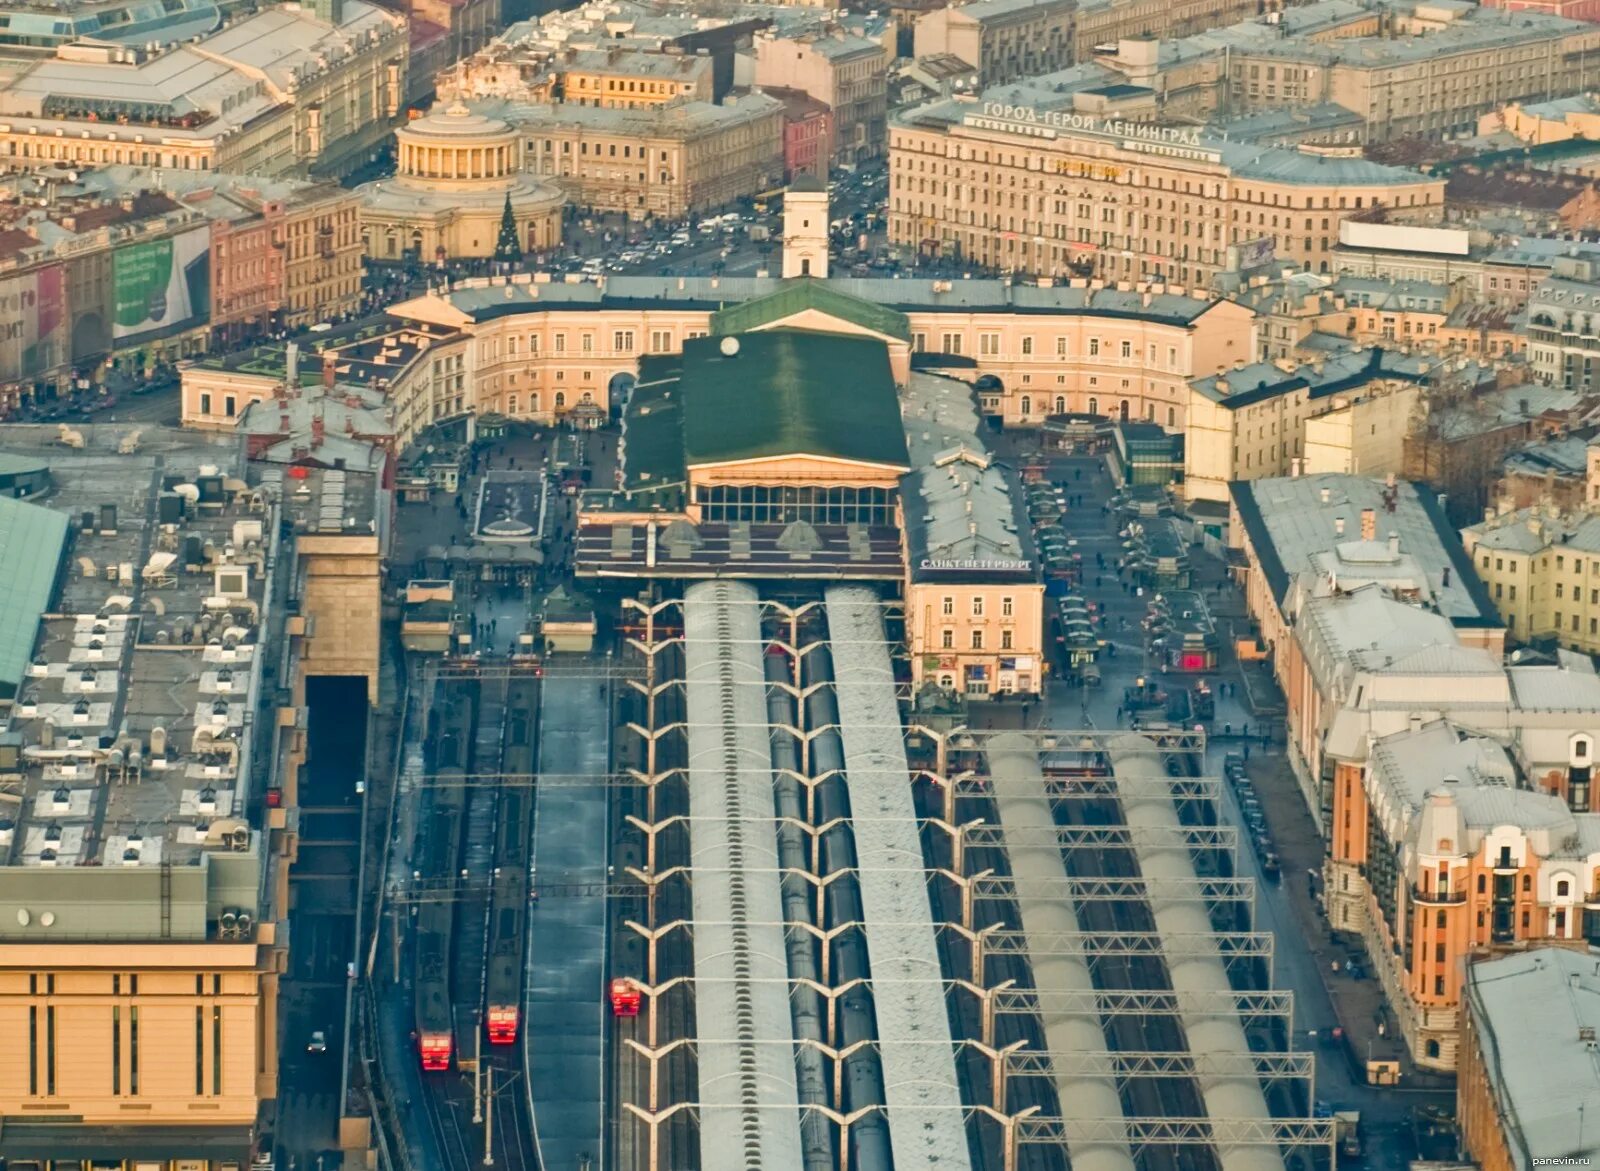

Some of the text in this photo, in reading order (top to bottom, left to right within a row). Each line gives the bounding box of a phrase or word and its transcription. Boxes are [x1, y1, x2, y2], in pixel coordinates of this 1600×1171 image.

[983, 102, 1201, 146] ГОРОД-ГЕРОЙ ЛЕНИНГРАД
[921, 559, 1031, 569] САНКТ-ПЕТЕРБУРГ
